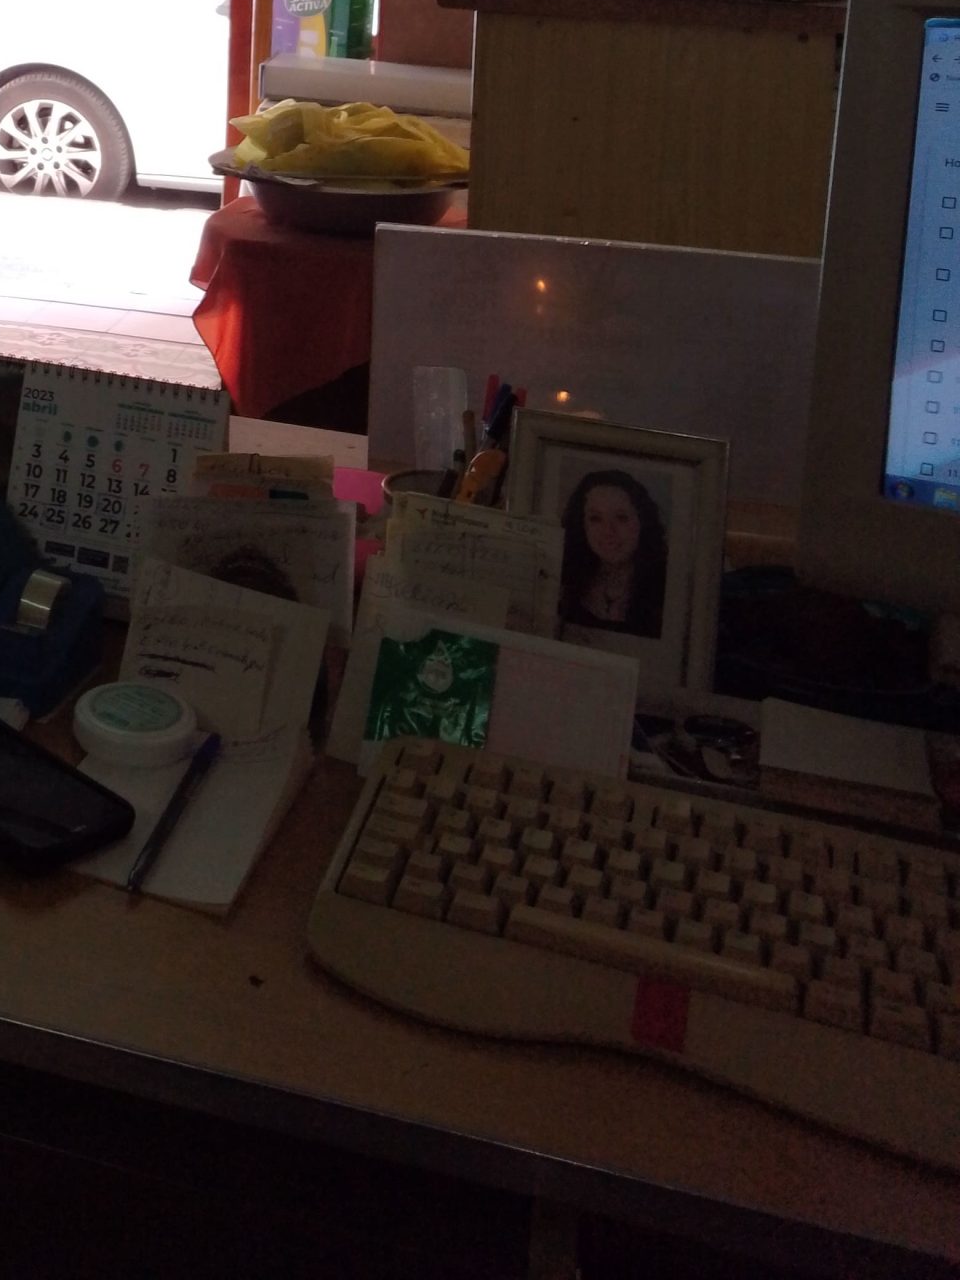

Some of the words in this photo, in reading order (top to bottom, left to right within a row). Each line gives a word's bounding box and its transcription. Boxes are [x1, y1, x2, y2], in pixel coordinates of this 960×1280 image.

[288, 0, 329, 13] ACTIVA
[23, 387, 55, 401] 2023
[22, 401, 58, 416] abril
[32, 443, 42, 458] 3
[59, 449, 70, 464] 4
[85, 454, 96, 468] 5
[112, 459, 123, 473] 6
[139, 464, 151, 477] 7
[166, 469, 177, 483] 8
[171, 448, 178, 463] 1
[26, 463, 43, 478] 10
[55, 468, 68, 483] 11
[81, 473, 96, 489] 12
[107, 478, 122, 494] 13
[133, 482, 151, 497] 14
[23, 482, 40, 498] 17
[50, 487, 67, 504] 18
[77, 492, 93, 508] 19
[101, 498, 122, 514] 20
[18, 502, 39, 519] 24
[45, 507, 65, 524] 25
[72, 513, 92, 530] 26
[98, 518, 120, 535] 27
